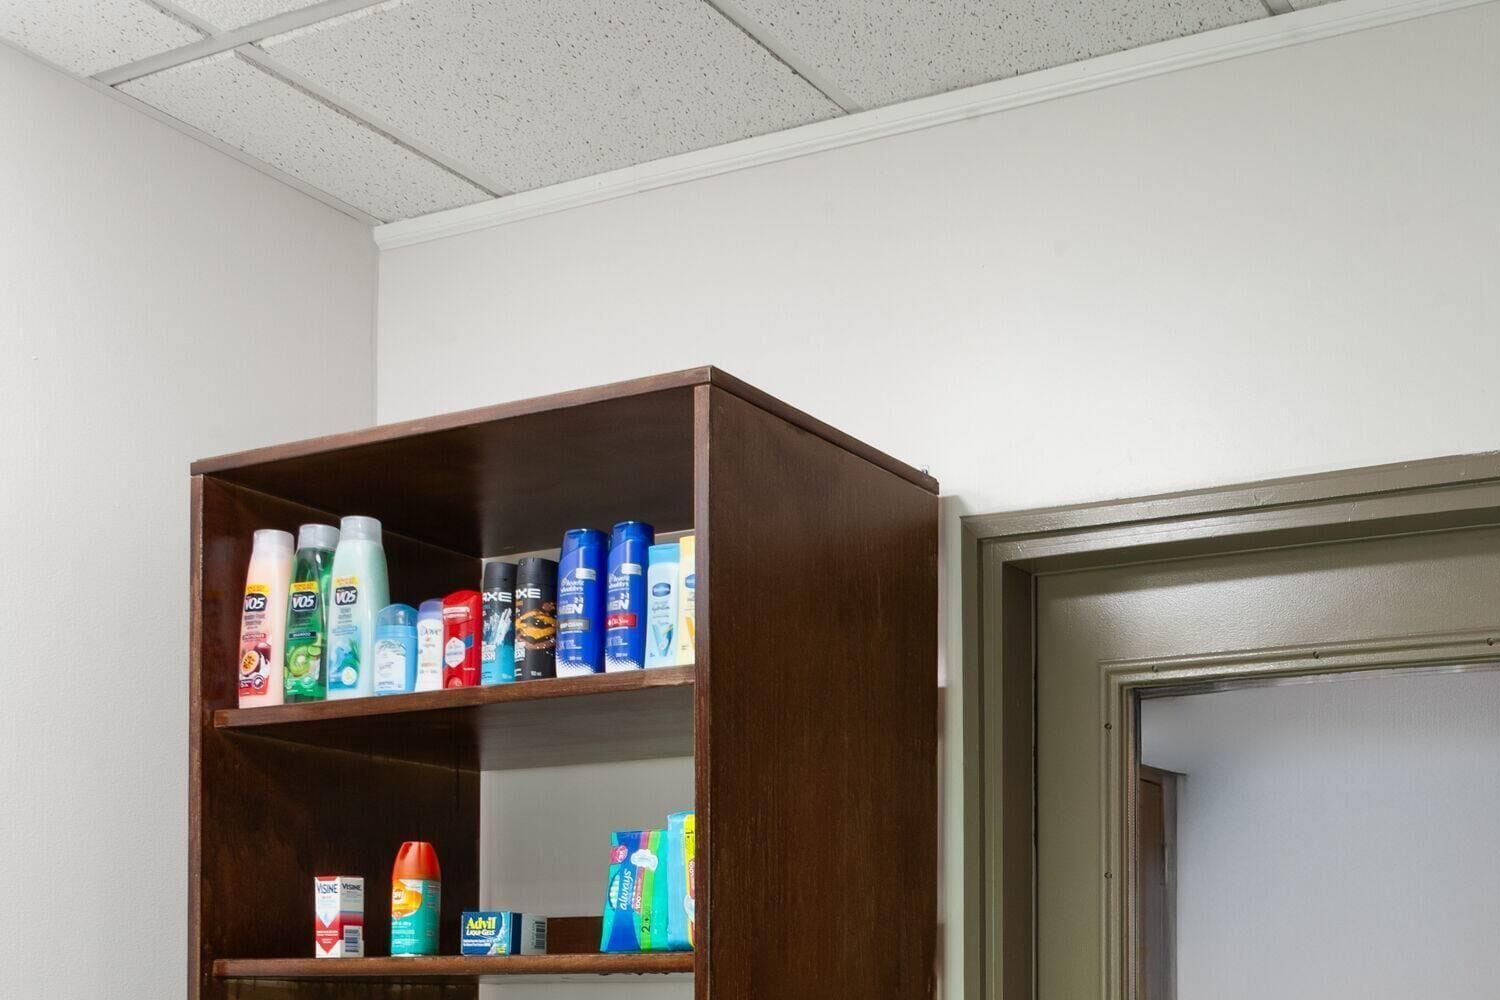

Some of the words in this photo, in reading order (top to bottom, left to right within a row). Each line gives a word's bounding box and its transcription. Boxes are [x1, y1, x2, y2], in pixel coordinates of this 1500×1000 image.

[317, 882, 338, 895] VISINE
[342, 882, 362, 892] VISINE
[619, 868, 633, 911] always
[466, 916, 496, 930] Advil
